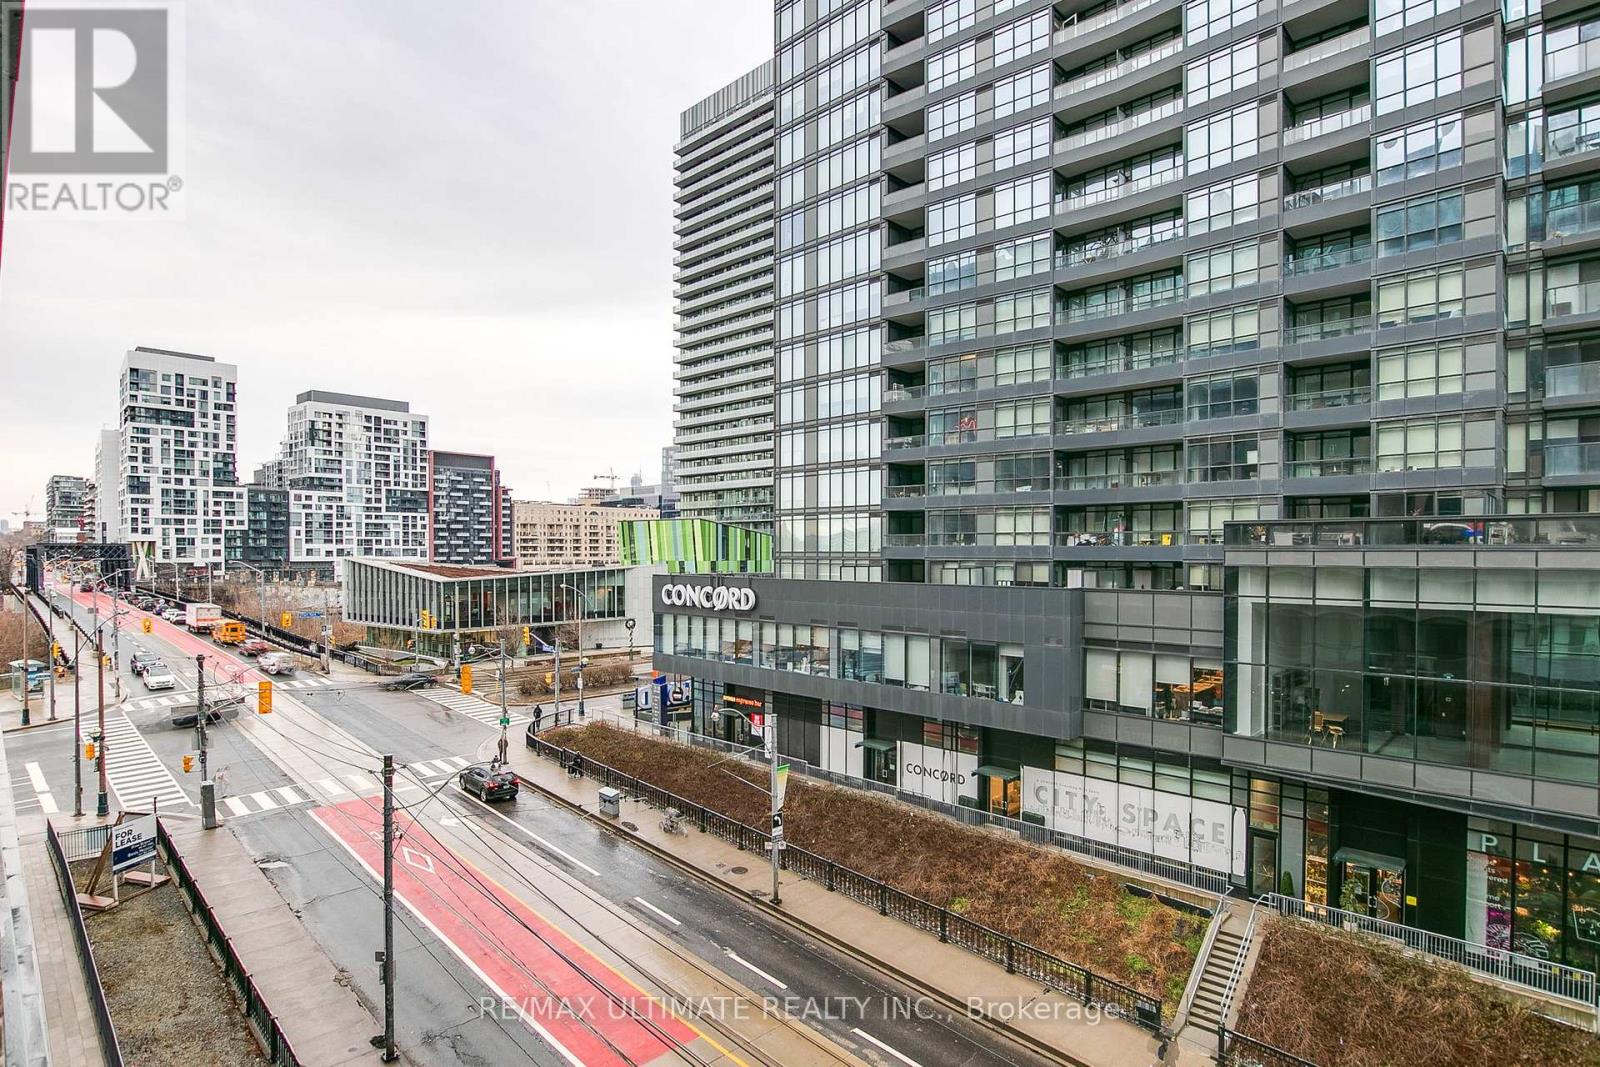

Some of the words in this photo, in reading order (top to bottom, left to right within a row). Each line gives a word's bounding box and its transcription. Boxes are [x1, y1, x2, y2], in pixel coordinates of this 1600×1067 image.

[1035, 785, 1099, 814] CITY
[1122, 803, 1225, 845] SPACE
[115, 829, 133, 840] FOR
[115, 833, 142, 848] LEASE
